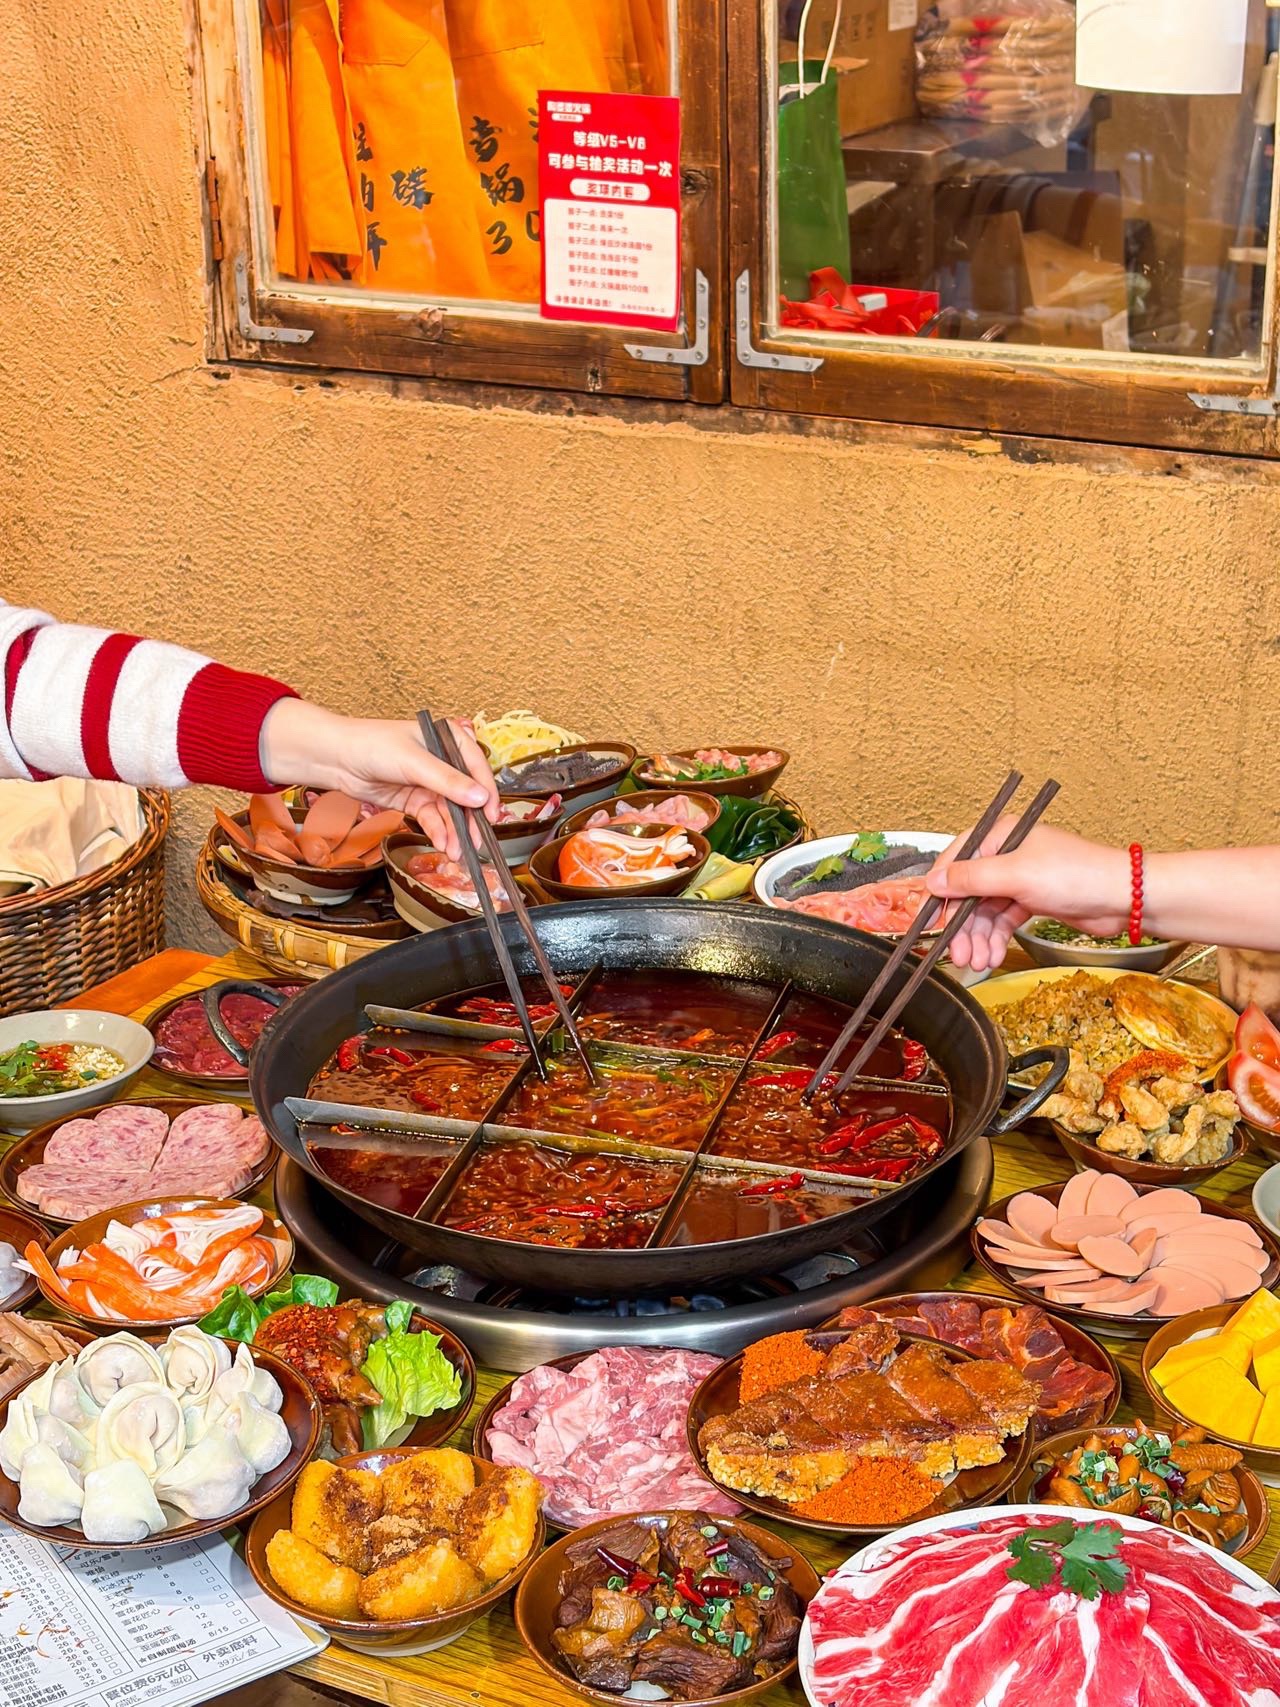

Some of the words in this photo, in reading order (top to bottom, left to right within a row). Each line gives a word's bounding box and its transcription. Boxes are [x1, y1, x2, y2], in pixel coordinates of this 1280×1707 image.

[548, 152, 673, 177] 可参与抽奖活动一次
[202, 1634, 259, 1663] 外卖底料
[105, 1662, 190, 1701] 餐位费6元/位
